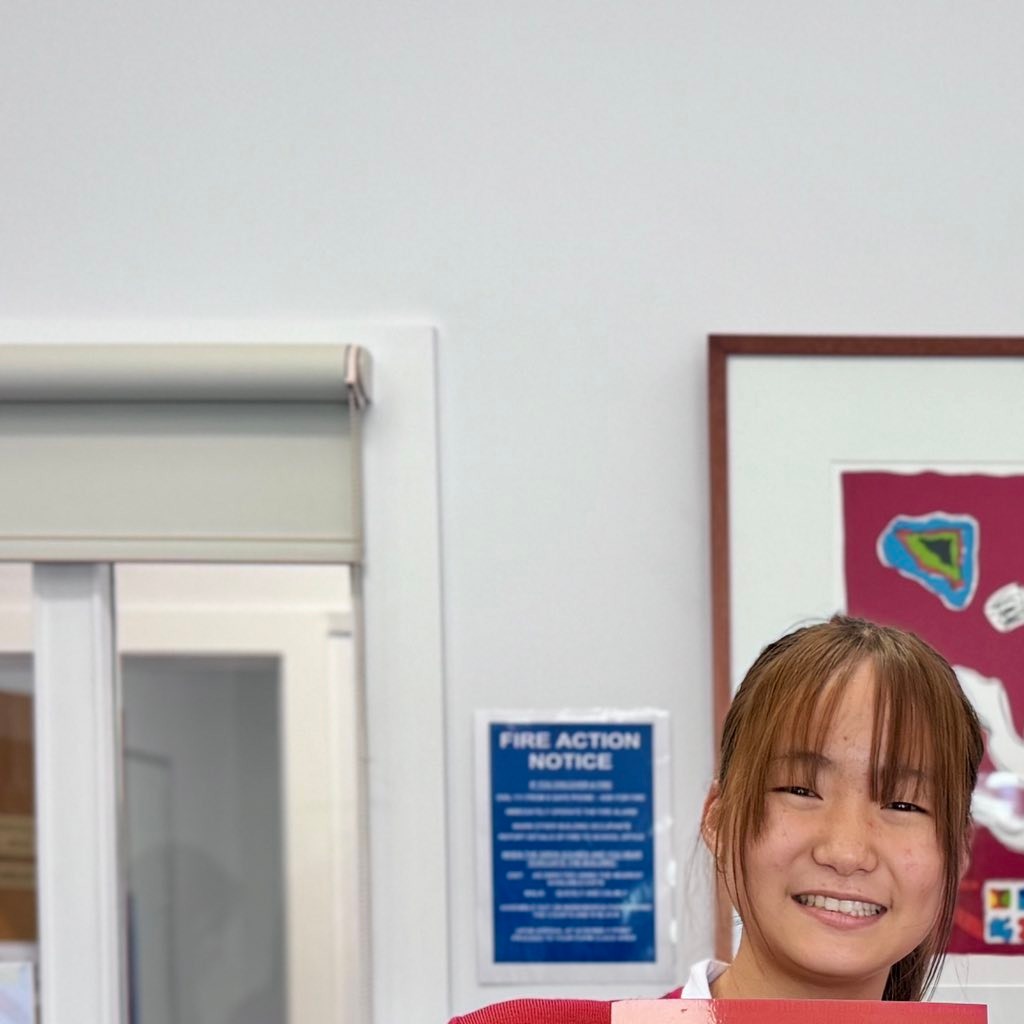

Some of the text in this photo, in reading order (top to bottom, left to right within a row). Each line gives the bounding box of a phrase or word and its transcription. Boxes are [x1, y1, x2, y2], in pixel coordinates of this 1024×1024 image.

[499, 731, 642, 750] FIRE ACTION
[528, 752, 613, 771] NOTICE
